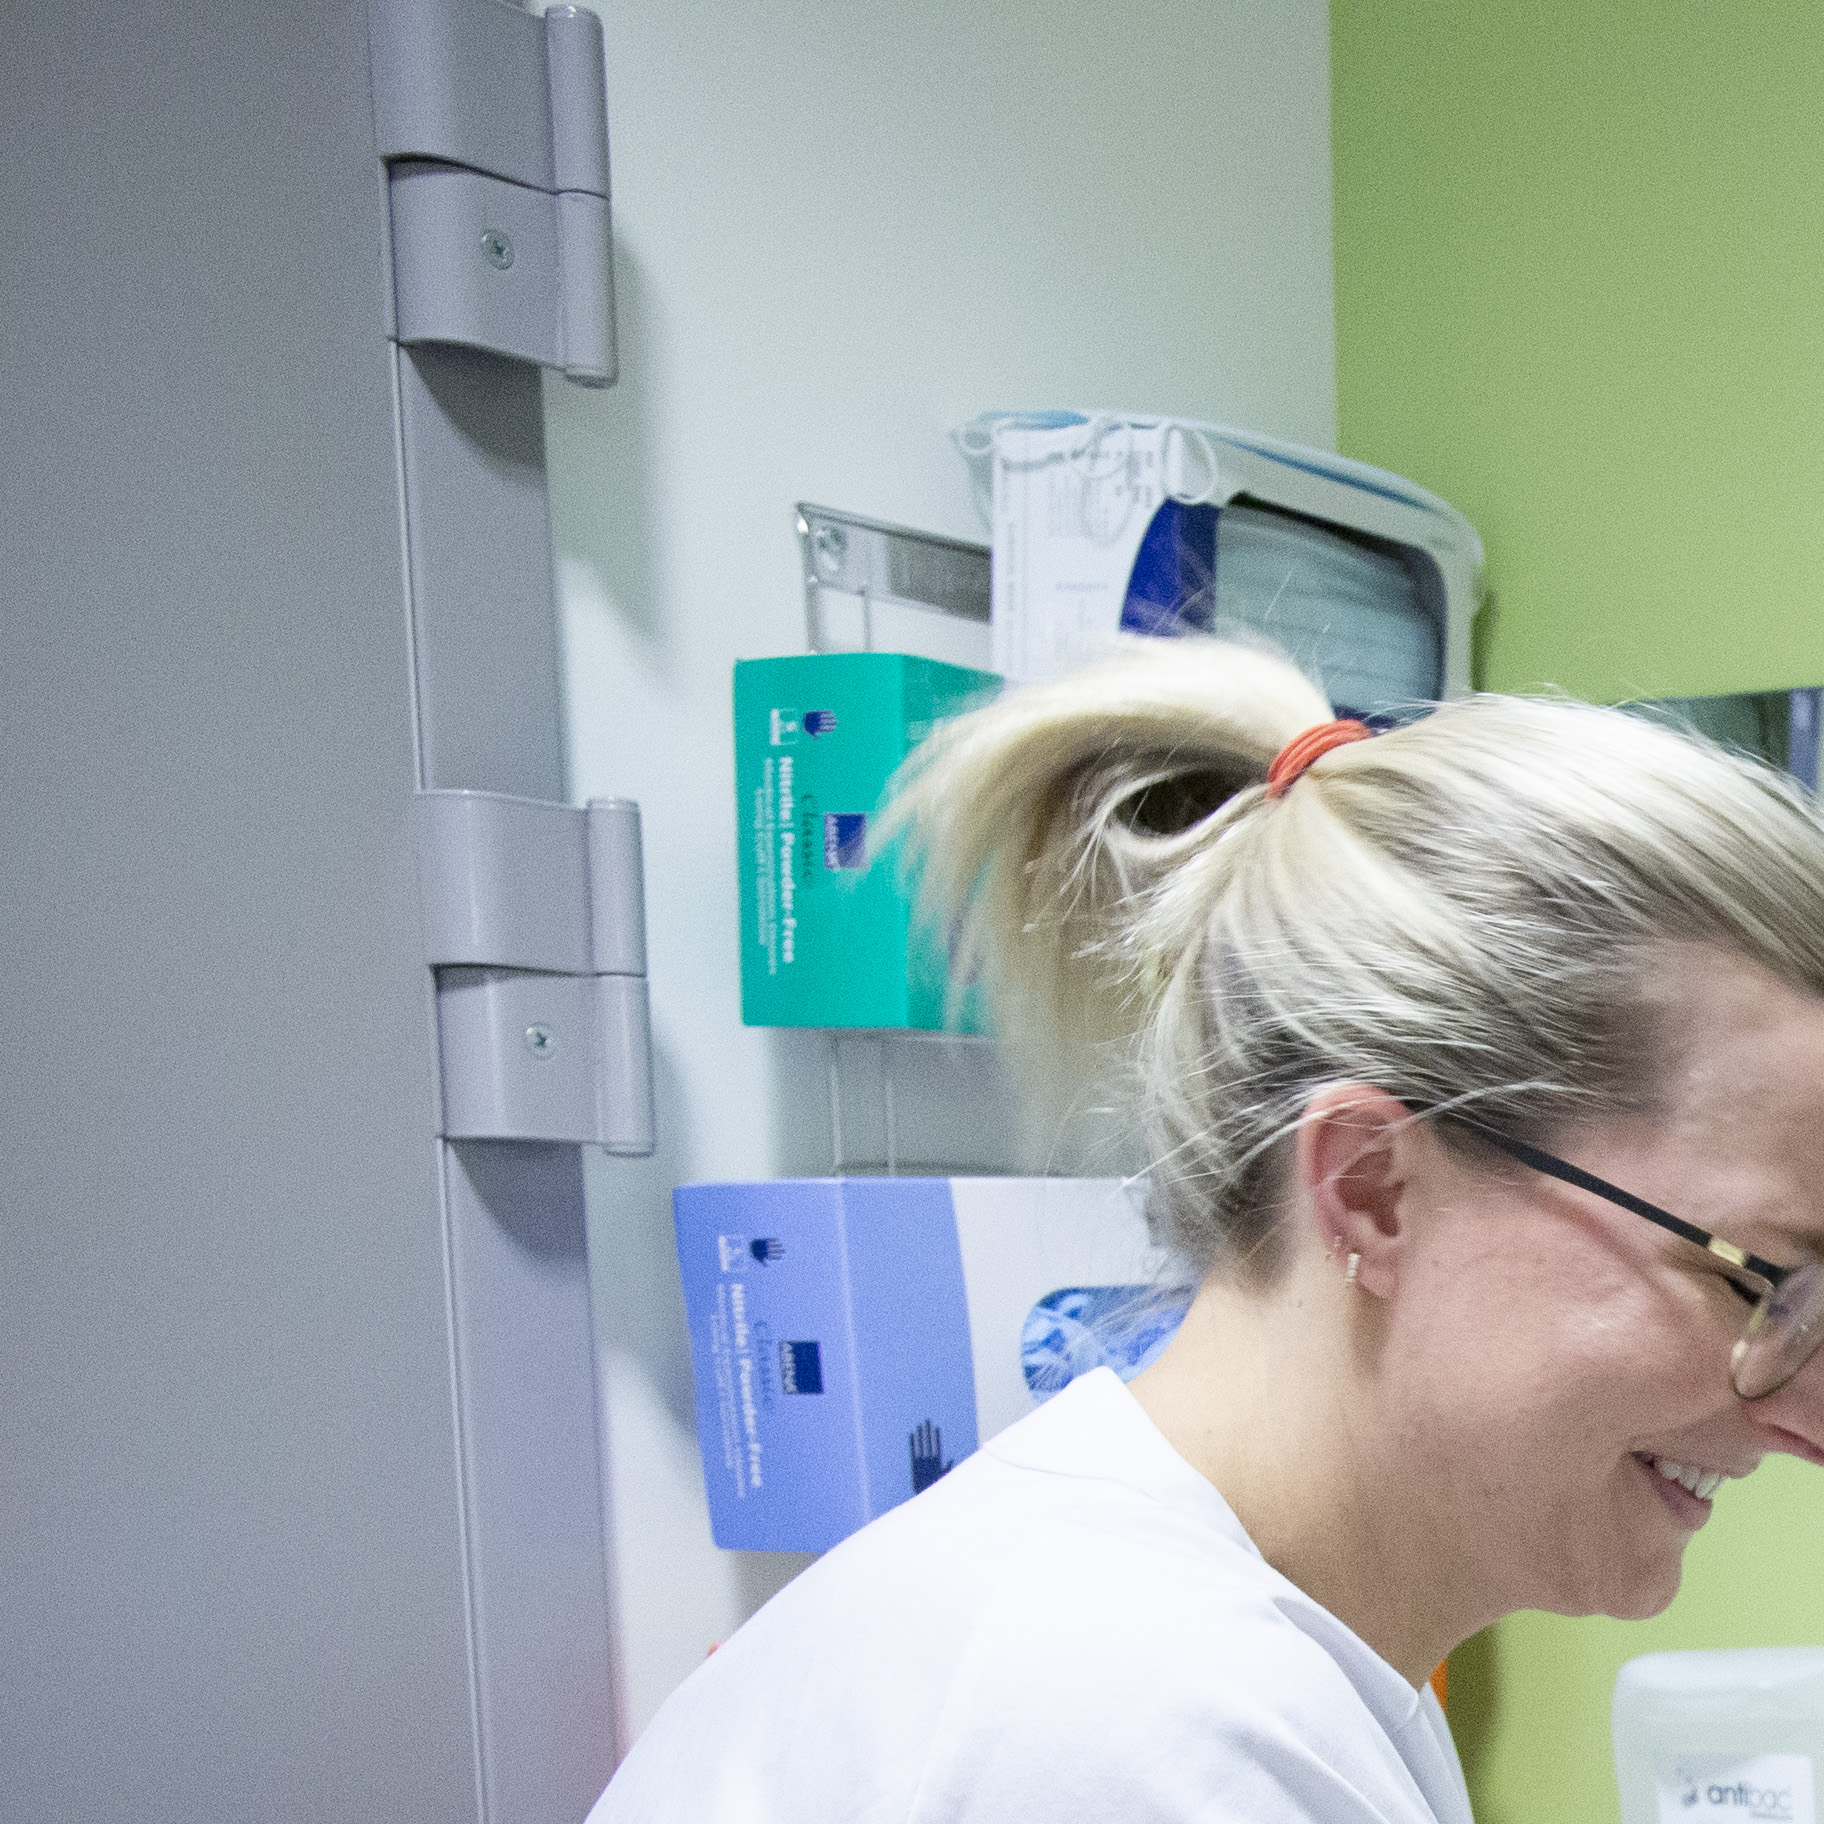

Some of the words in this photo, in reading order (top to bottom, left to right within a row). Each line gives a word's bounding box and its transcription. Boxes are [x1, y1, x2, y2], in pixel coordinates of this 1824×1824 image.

[778, 756, 796, 821] Nitrile
[800, 793, 819, 882] Classic
[780, 832, 797, 964] Powder-Free
[730, 1283, 750, 1348] Nitrile
[738, 1357, 764, 1489] Powder-Free
[1706, 1783, 1793, 1812] antibac
